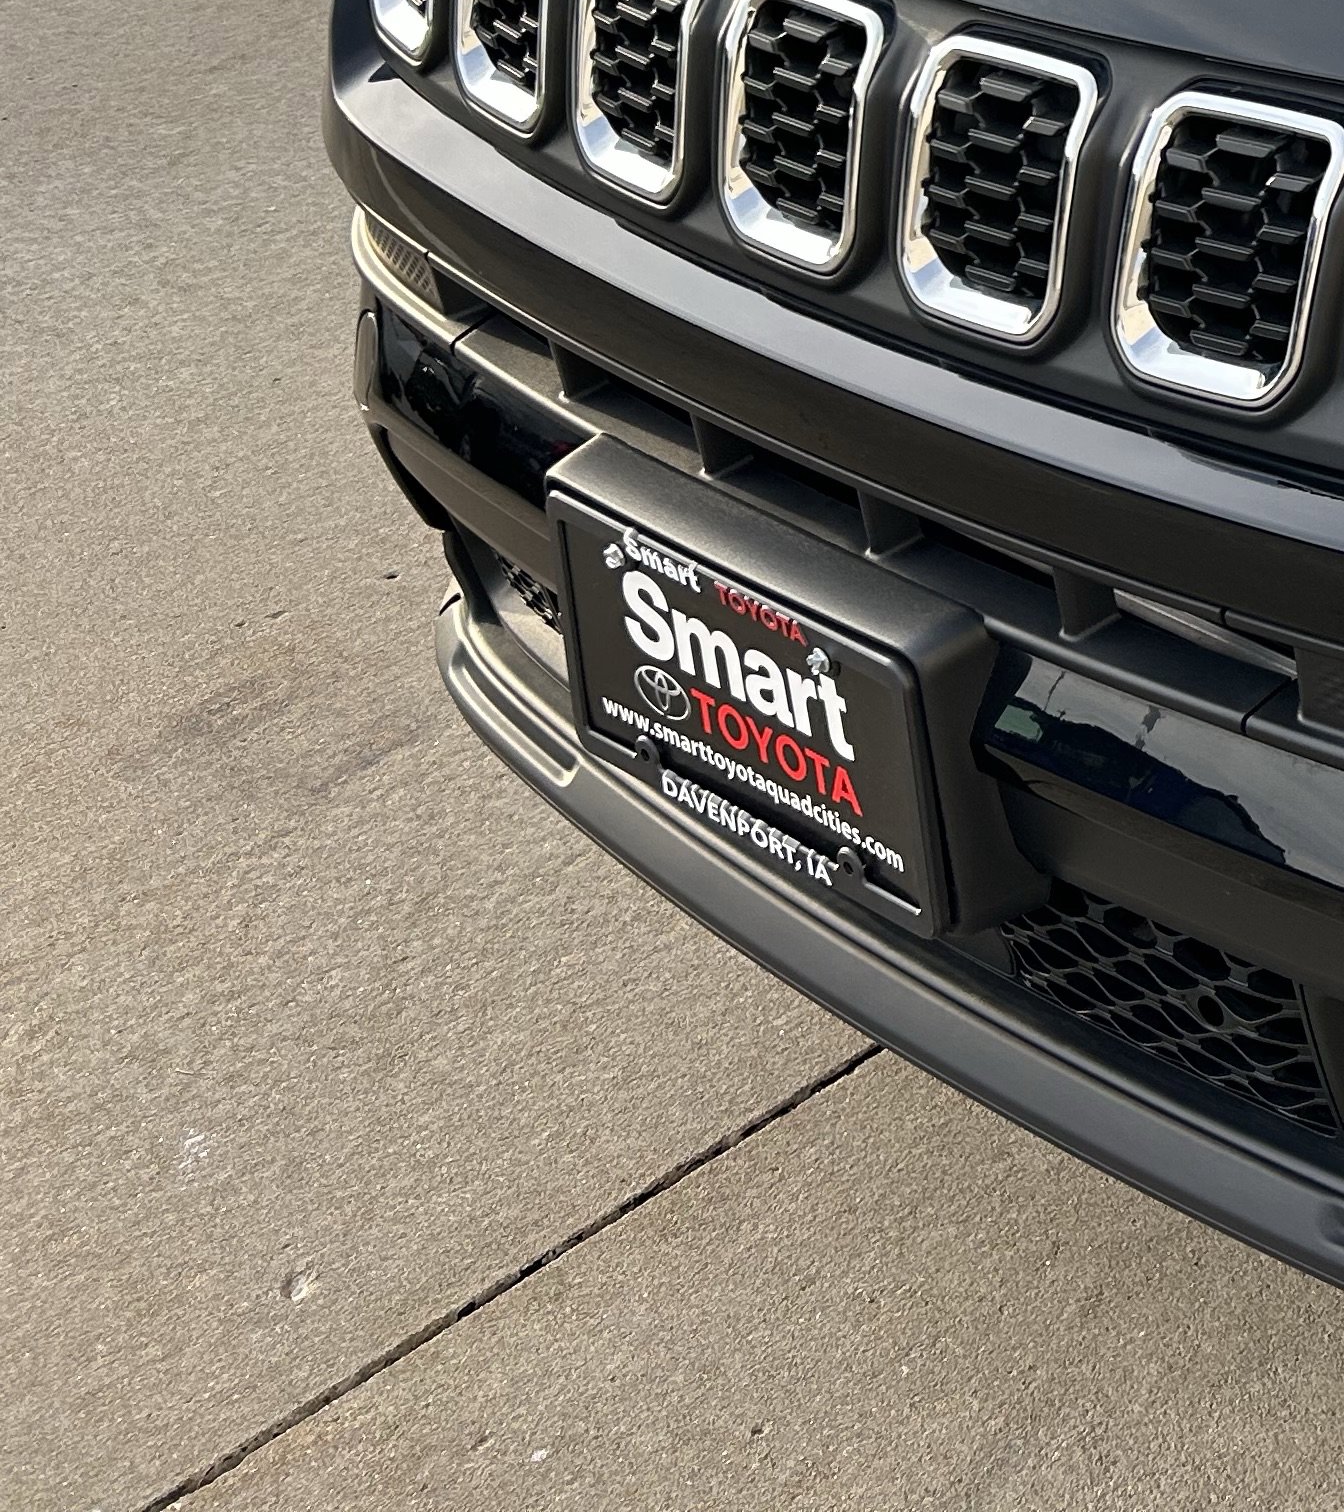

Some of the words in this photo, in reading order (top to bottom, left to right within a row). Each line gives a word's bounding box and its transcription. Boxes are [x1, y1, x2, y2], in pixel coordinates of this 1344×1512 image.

[623, 527, 702, 593] Smart
[714, 580, 808, 648] TOYOTA
[622, 570, 855, 763] Smart
[602, 696, 905, 873] www.smarttoyotaquadcities.com
[690, 687, 863, 817] TOYOTA
[661, 769, 802, 872] DAVENPORT,
[806, 848, 833, 887] IA
